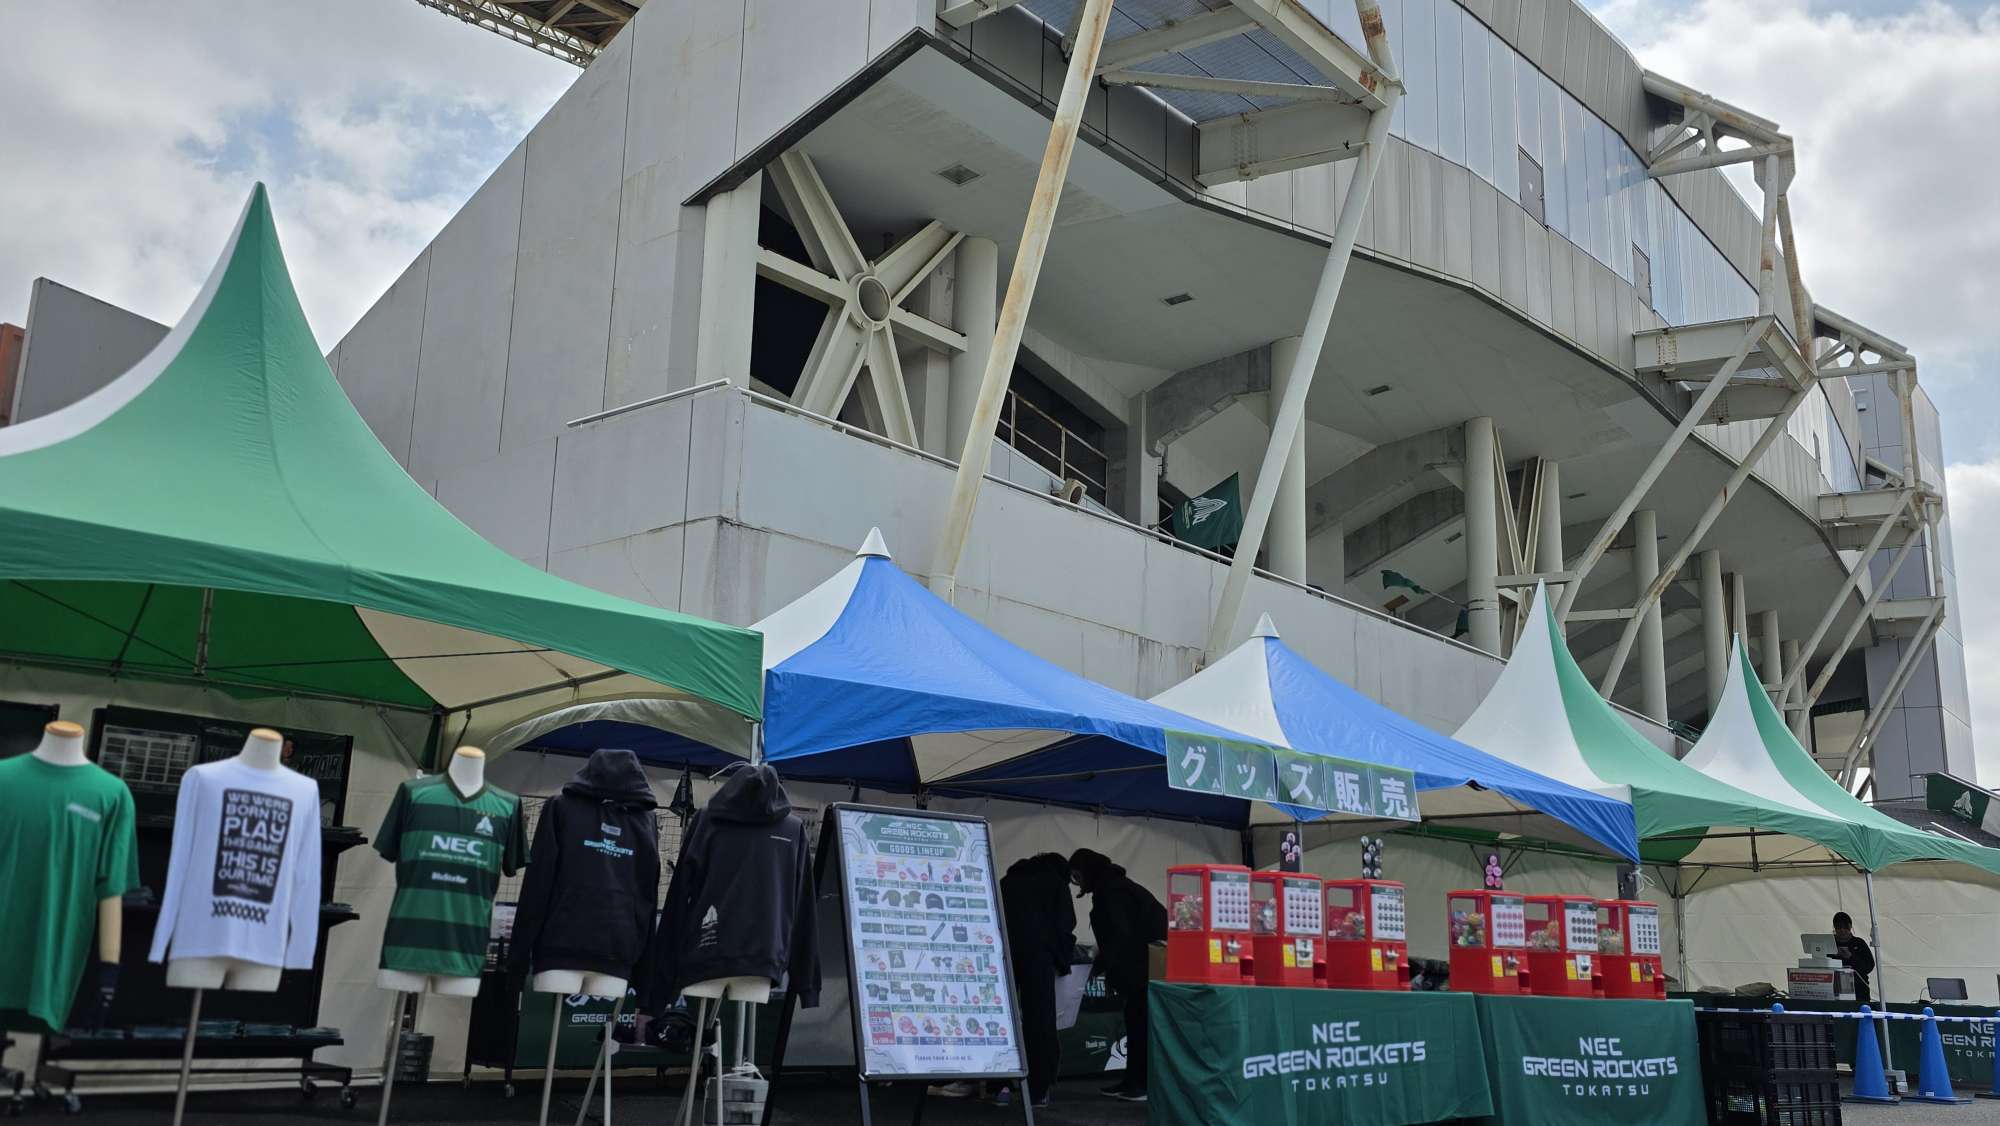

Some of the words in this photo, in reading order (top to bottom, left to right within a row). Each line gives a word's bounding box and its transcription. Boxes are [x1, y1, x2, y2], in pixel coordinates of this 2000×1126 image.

[1181, 746, 1408, 817] グッズ販売
[228, 792, 249, 803] WE
[252, 794, 290, 811] WERE
[226, 803, 268, 819] BORN
[272, 810, 288, 823] TO
[224, 817, 286, 843] PLAY
[432, 835, 484, 856] NEC
[890, 844, 914, 854] GOODS
[222, 851, 258, 870] THIS
[261, 857, 278, 874] IS
[218, 868, 246, 881] OUR
[247, 872, 274, 888] TIME
[1312, 1021, 1360, 1044] NEC
[1969, 1022, 1995, 1034] NE
[1579, 1037, 1622, 1056] NEC
[1243, 1049, 1321, 1079] GREEN
[1326, 1041, 1426, 1068] ROCKETS
[1522, 1056, 1589, 1077] GREEN
[1592, 1056, 1678, 1078] ROCKETS
[1291, 1073, 1387, 1092] TOKATSU
[1562, 1084, 1648, 1096] TOKATSU
